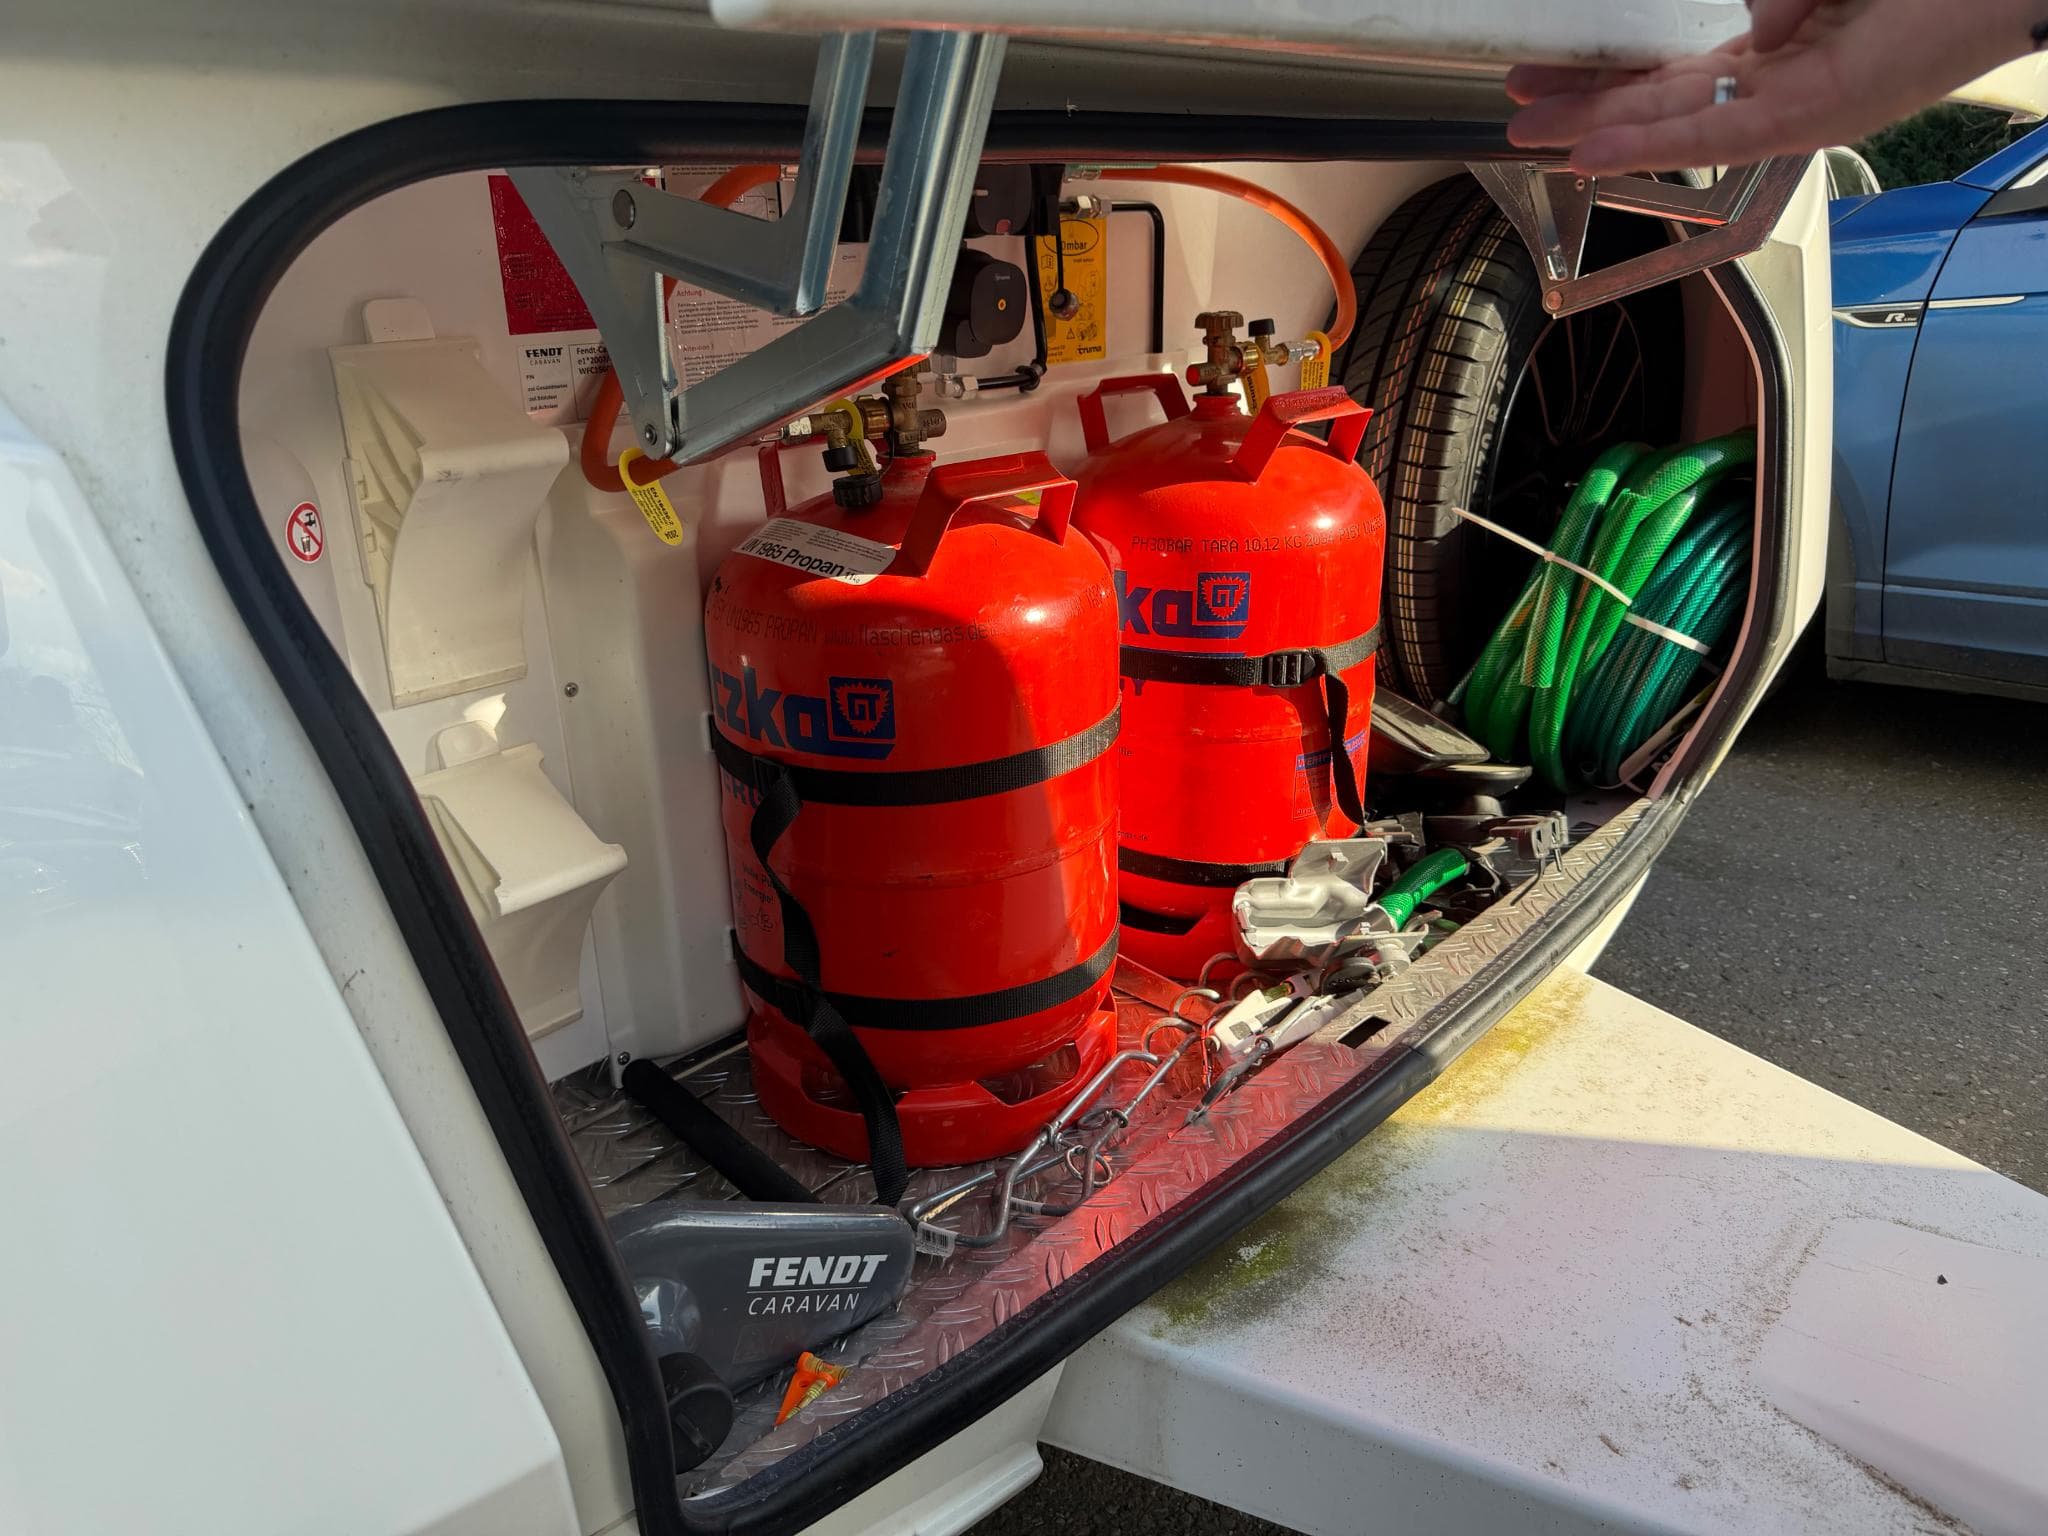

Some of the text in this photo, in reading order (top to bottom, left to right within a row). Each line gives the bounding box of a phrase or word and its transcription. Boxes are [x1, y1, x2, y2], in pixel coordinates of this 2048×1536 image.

[1884, 312, 1906, 323] R
[525, 347, 563, 358] FENDT
[1201, 538, 1240, 553] TARA
[1283, 534, 1303, 550] KG
[755, 541, 788, 558] 1965
[782, 547, 845, 578] Propan
[763, 614, 818, 643] PROPAN
[749, 1253, 889, 1288] FENDT
[748, 1292, 860, 1316] CARAVAN
